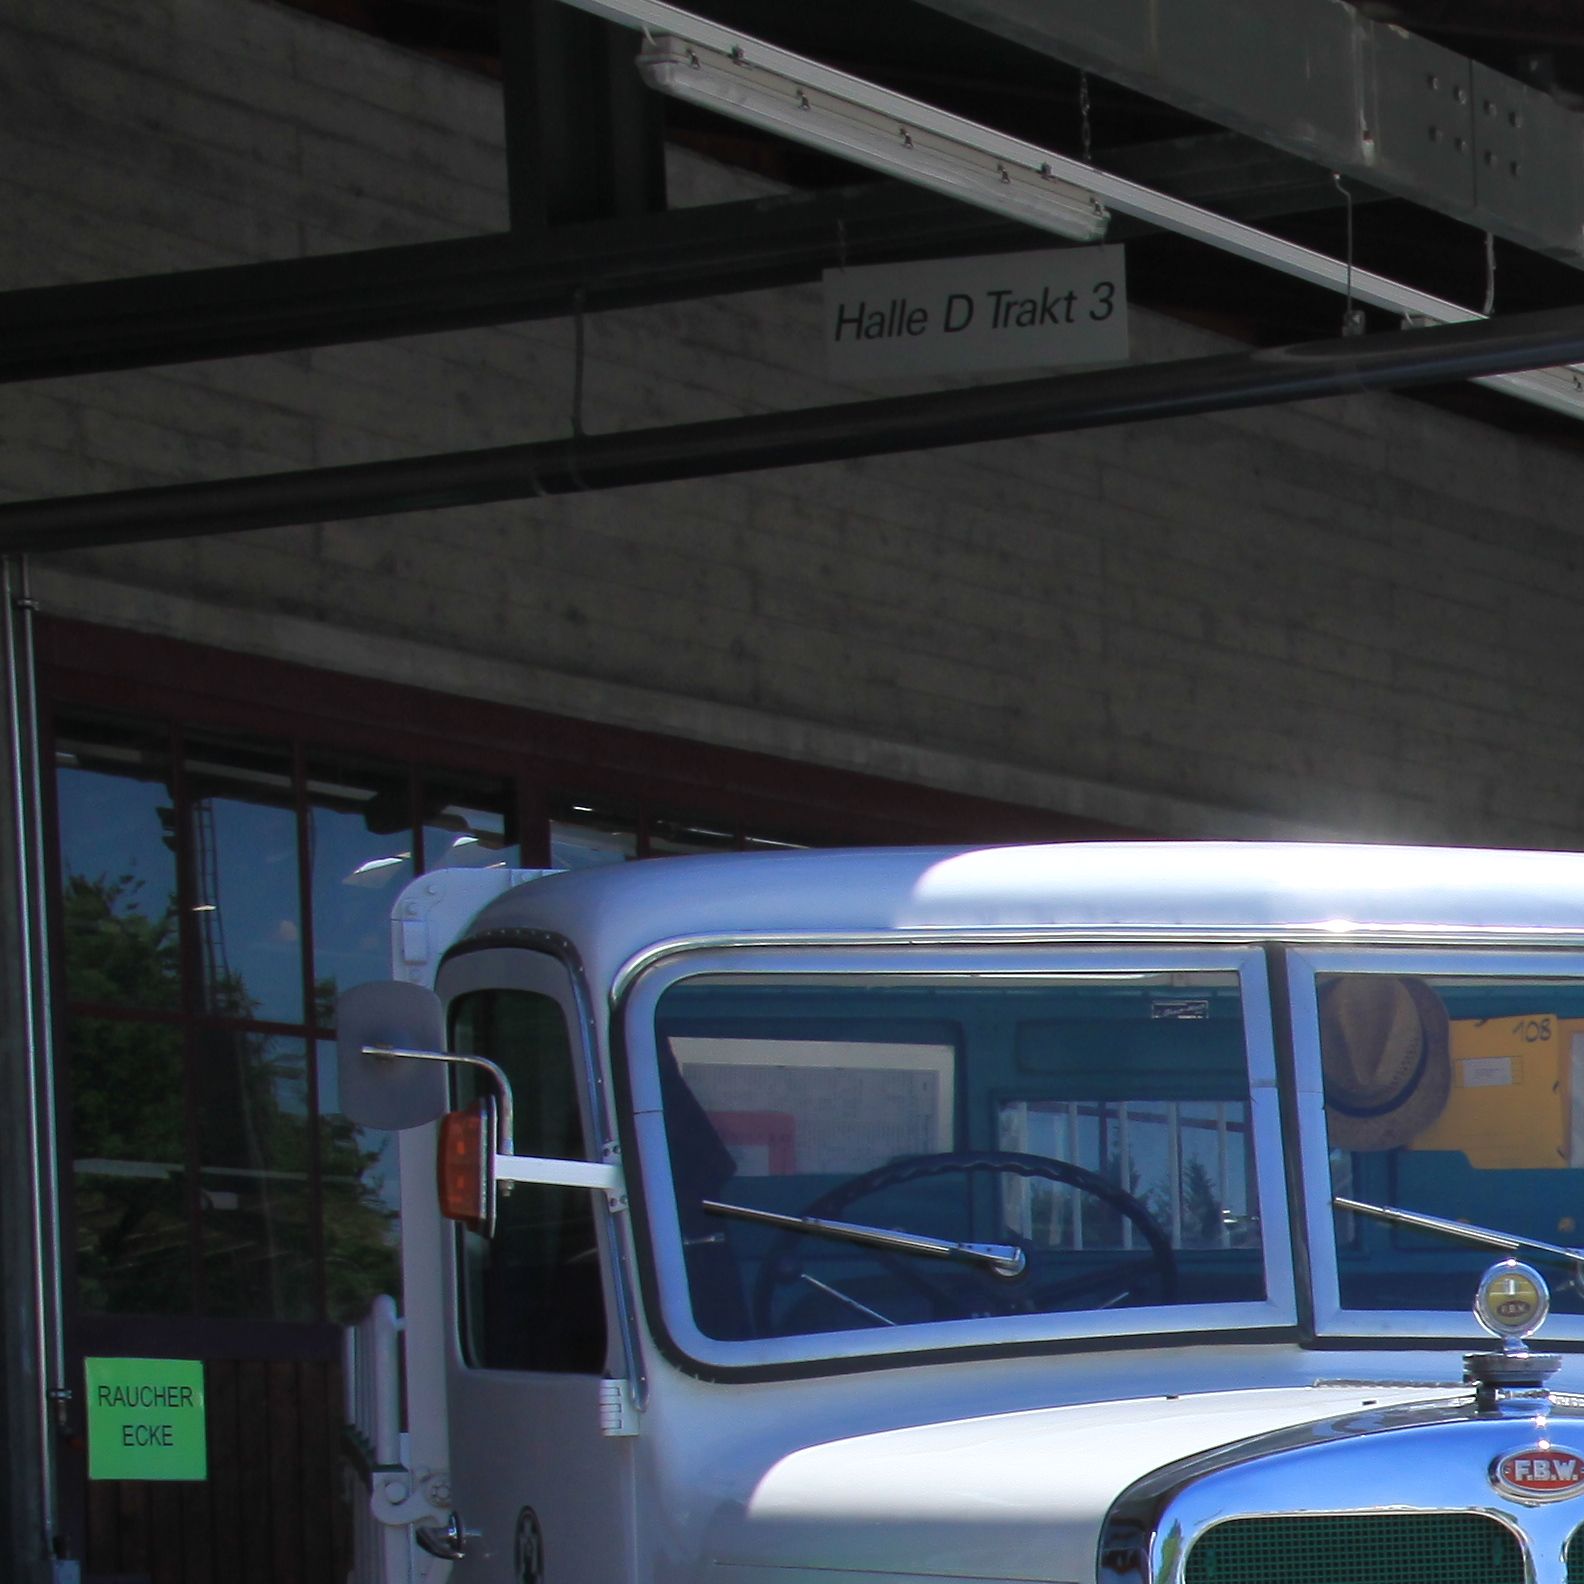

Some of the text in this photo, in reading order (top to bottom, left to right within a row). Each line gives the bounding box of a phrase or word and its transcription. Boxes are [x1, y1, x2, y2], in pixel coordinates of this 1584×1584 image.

[834, 281, 1117, 343] Halle D Trakt 3
[1511, 1018, 1553, 1043] 108
[97, 1385, 194, 1409] RAUCHER
[121, 1424, 174, 1448] ECKE
[1513, 1459, 1579, 1483] F.B.W.
